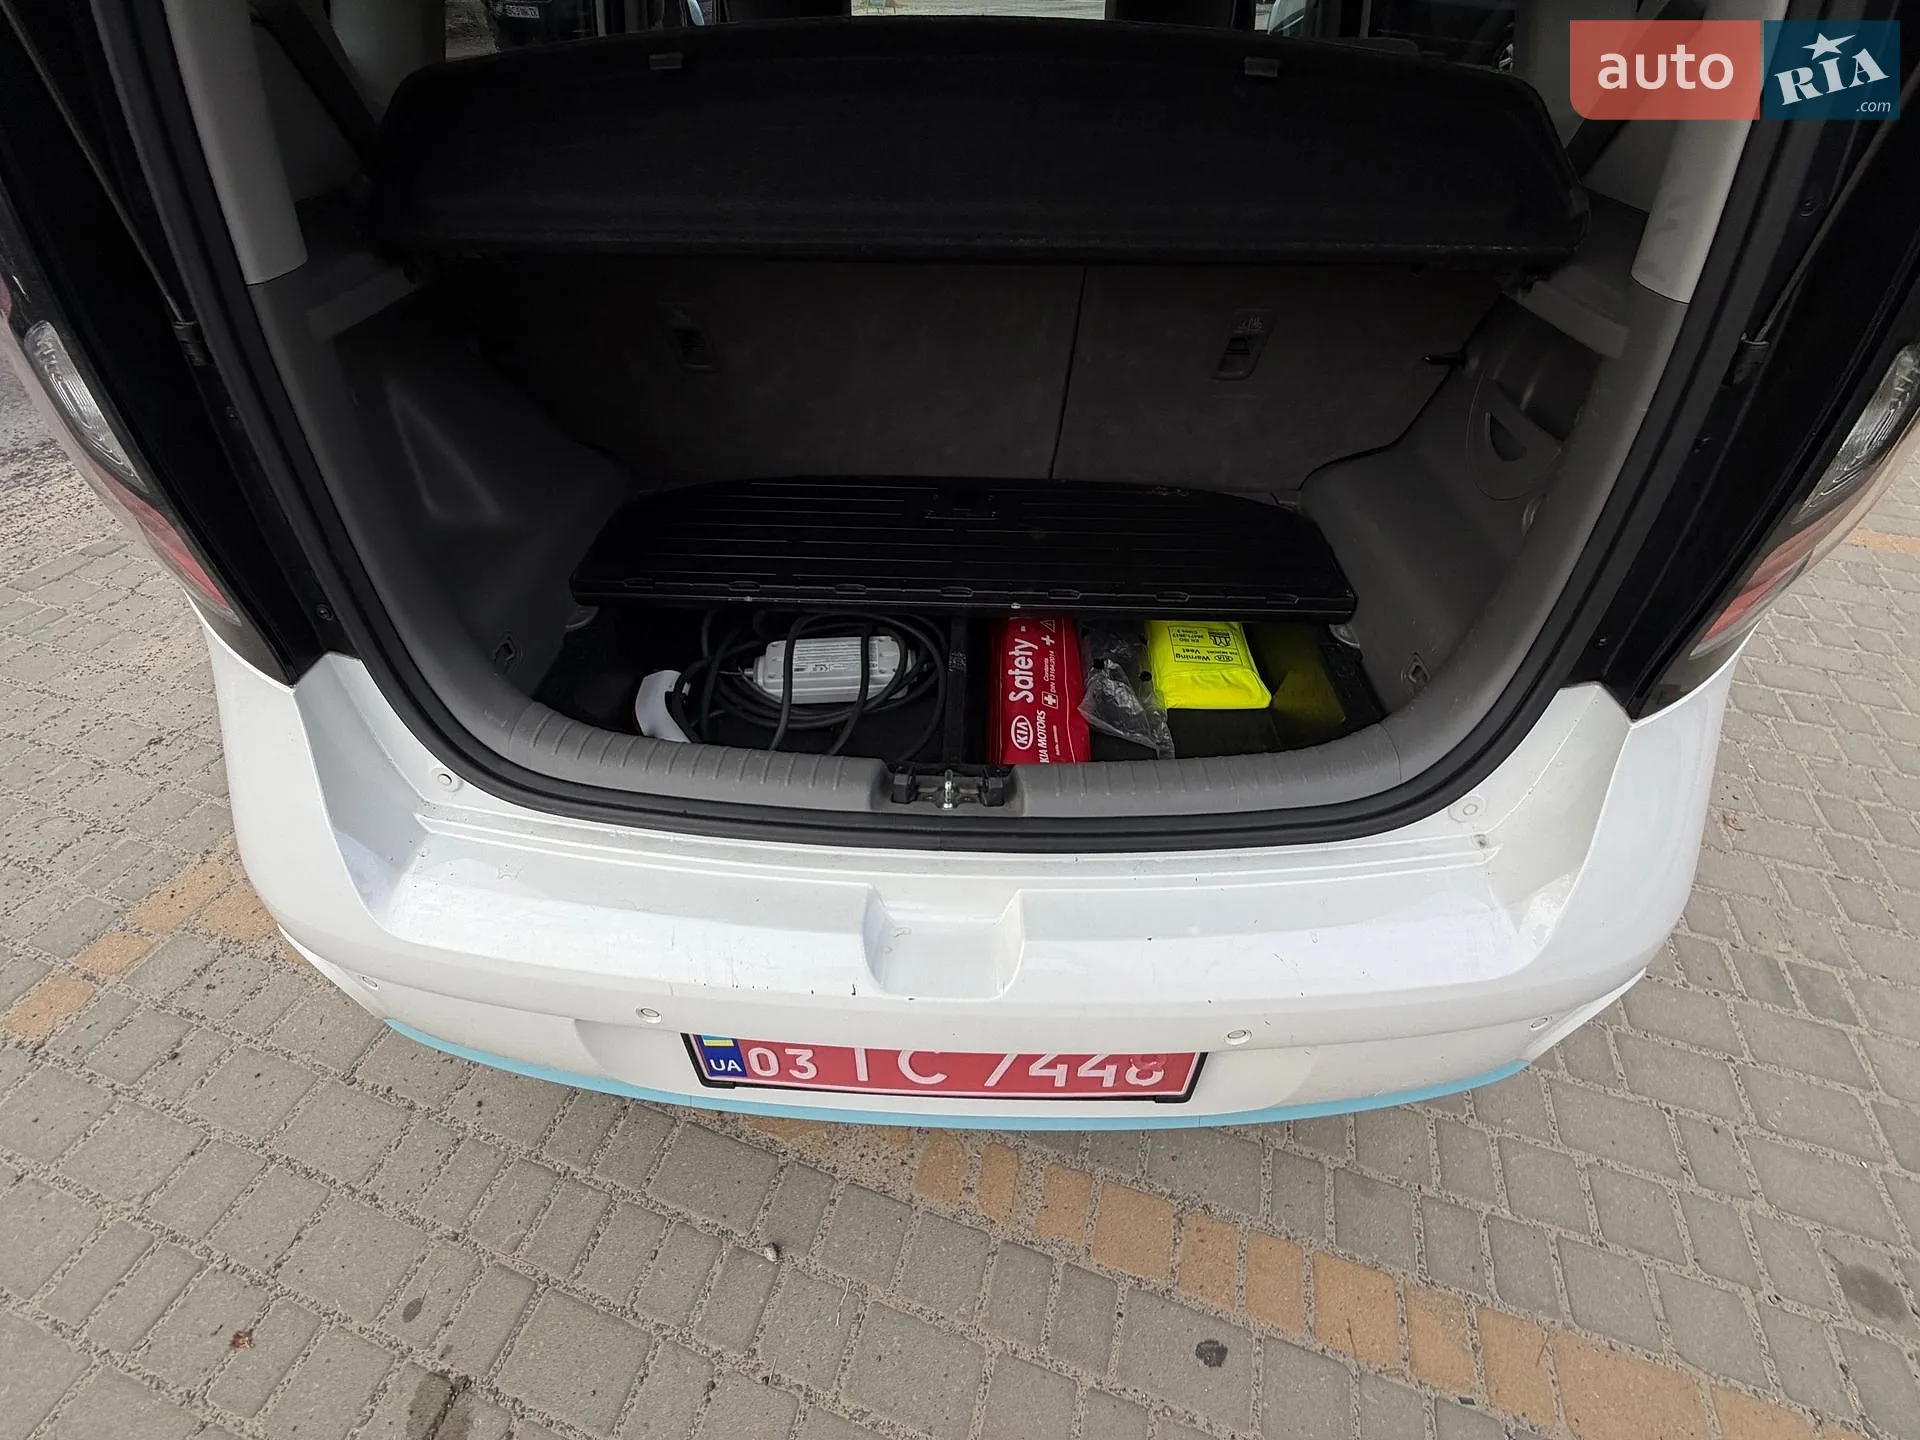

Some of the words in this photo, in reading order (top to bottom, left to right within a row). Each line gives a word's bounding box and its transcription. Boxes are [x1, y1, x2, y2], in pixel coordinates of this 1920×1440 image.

[1175, 653, 1211, 662] Warning
[1008, 638, 1039, 703] Safety
[1036, 709, 1048, 749] MOTORS
[1039, 749, 1050, 764] KIA
[710, 1058, 742, 1073] UA
[747, 1047, 818, 1080] 03
